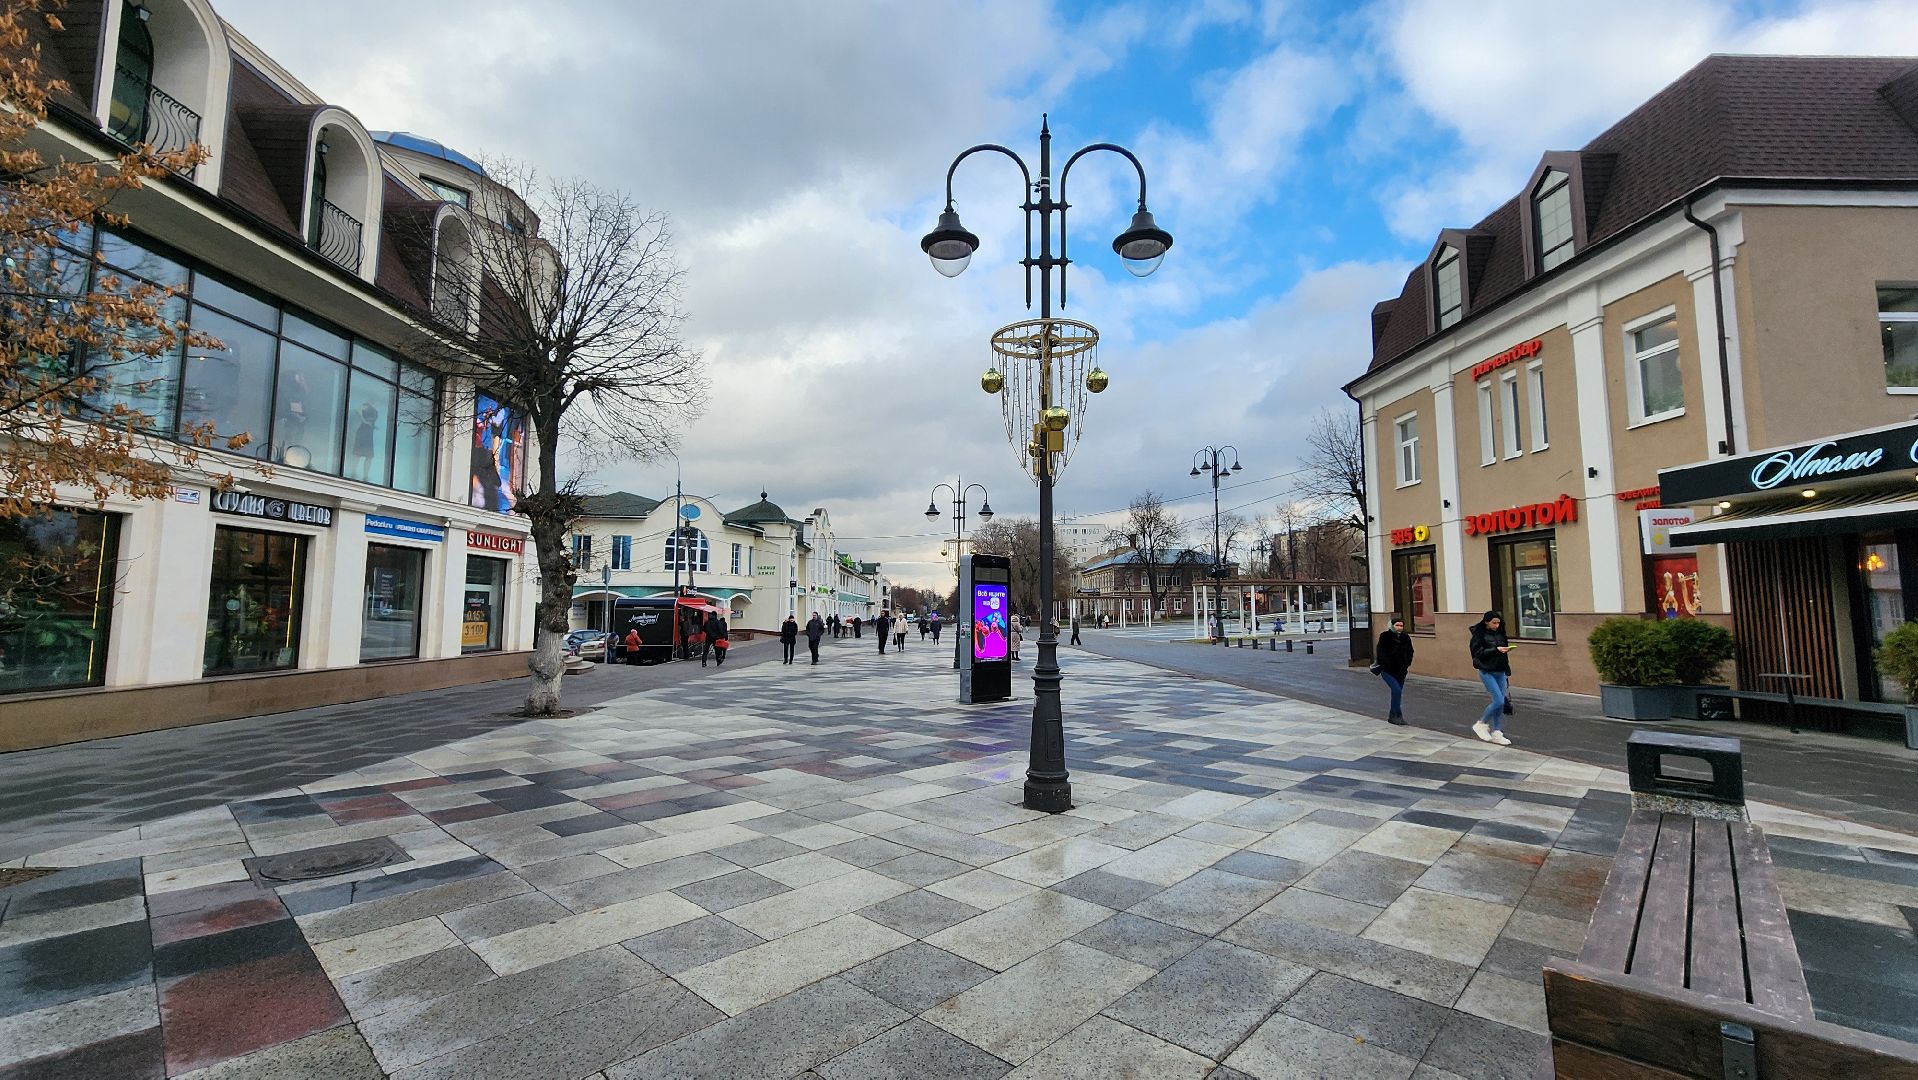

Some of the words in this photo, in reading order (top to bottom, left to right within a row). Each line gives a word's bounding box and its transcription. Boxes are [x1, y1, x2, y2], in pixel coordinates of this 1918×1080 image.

[1751, 441, 1884, 490] Ателье
[214, 492, 266, 516] СТУДИЯ
[288, 502, 331, 525] ЦВЕТОВ
[1465, 494, 1578, 537] ЗОЛОТОЙ
[467, 532, 523, 552] SUNLIGHT
[1391, 527, 1415, 545] 585
